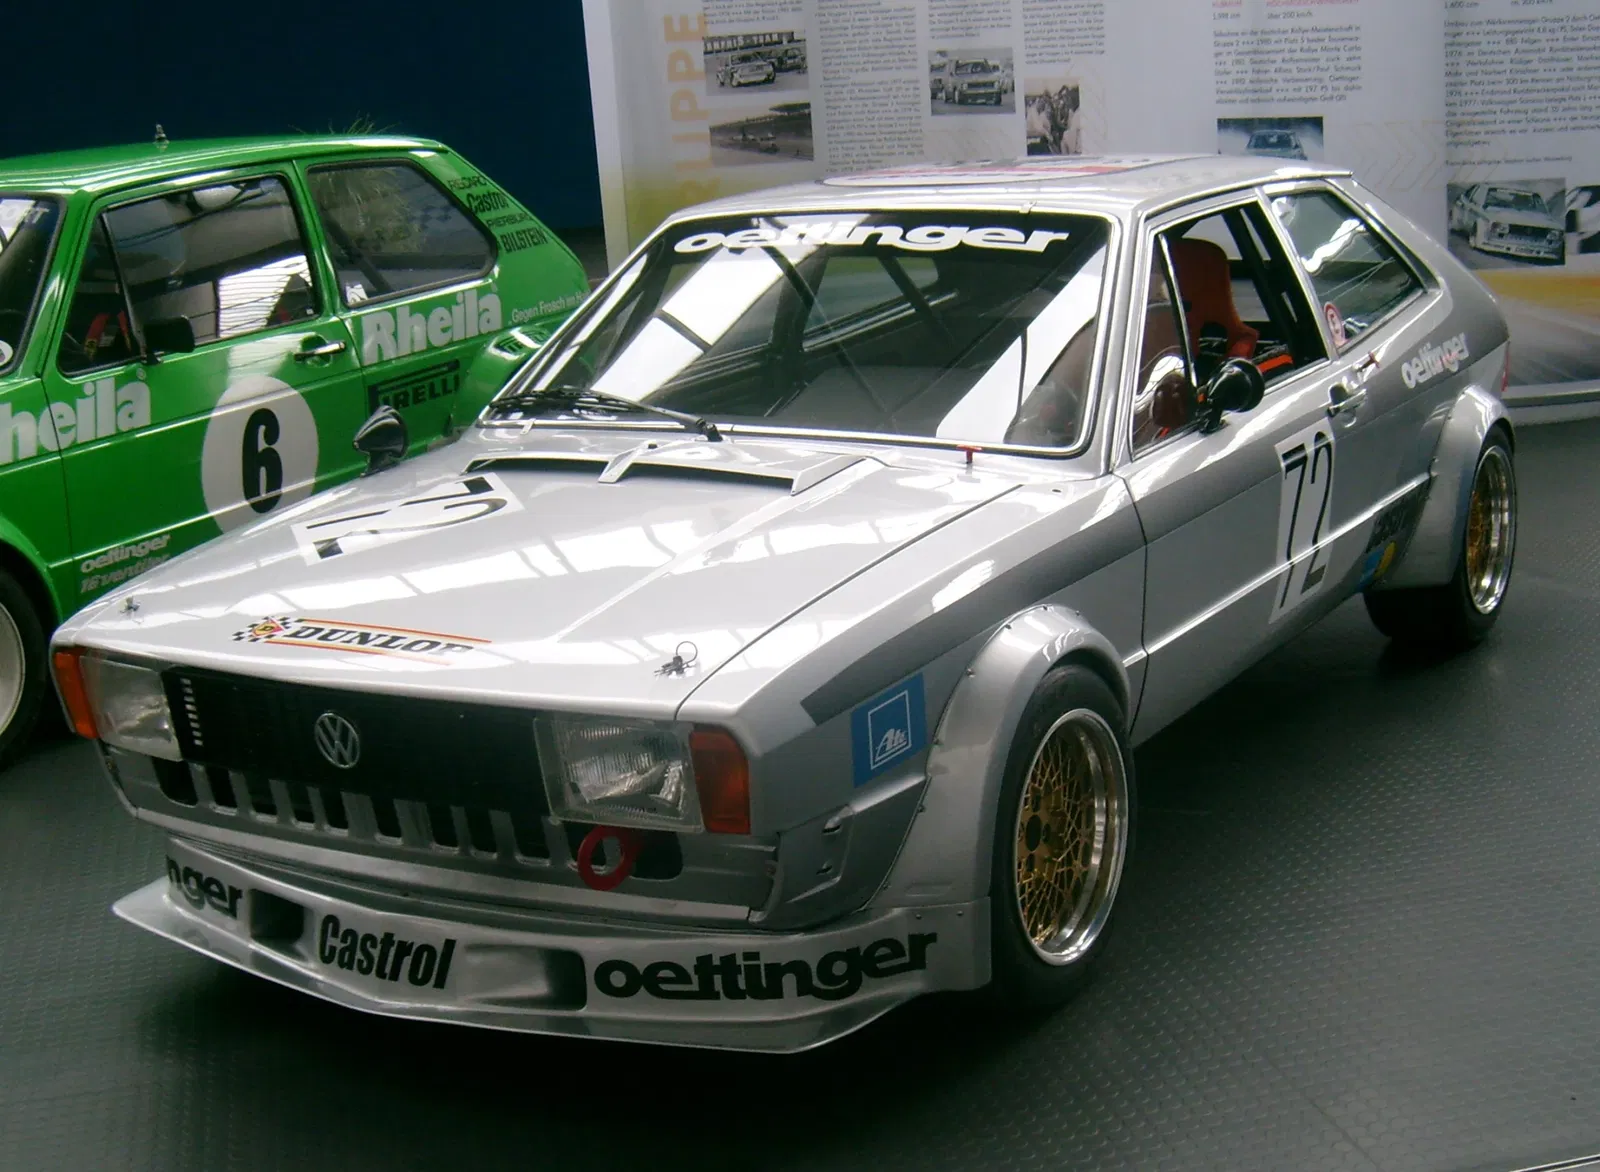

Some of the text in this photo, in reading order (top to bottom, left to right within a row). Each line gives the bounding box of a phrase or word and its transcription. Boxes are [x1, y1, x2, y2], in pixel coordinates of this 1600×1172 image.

[499, 226, 549, 254] BILSTEIN
[673, 221, 1070, 252] oettinger
[361, 288, 502, 366] Rheila
[1401, 332, 1469, 389] oettinger
[242, 407, 283, 514] 6
[1280, 431, 1332, 608] 72
[81, 533, 170, 573] oettinger
[284, 629, 474, 655] DUNLOP
[318, 914, 457, 990] Castrol
[594, 932, 937, 1001] oettinger
